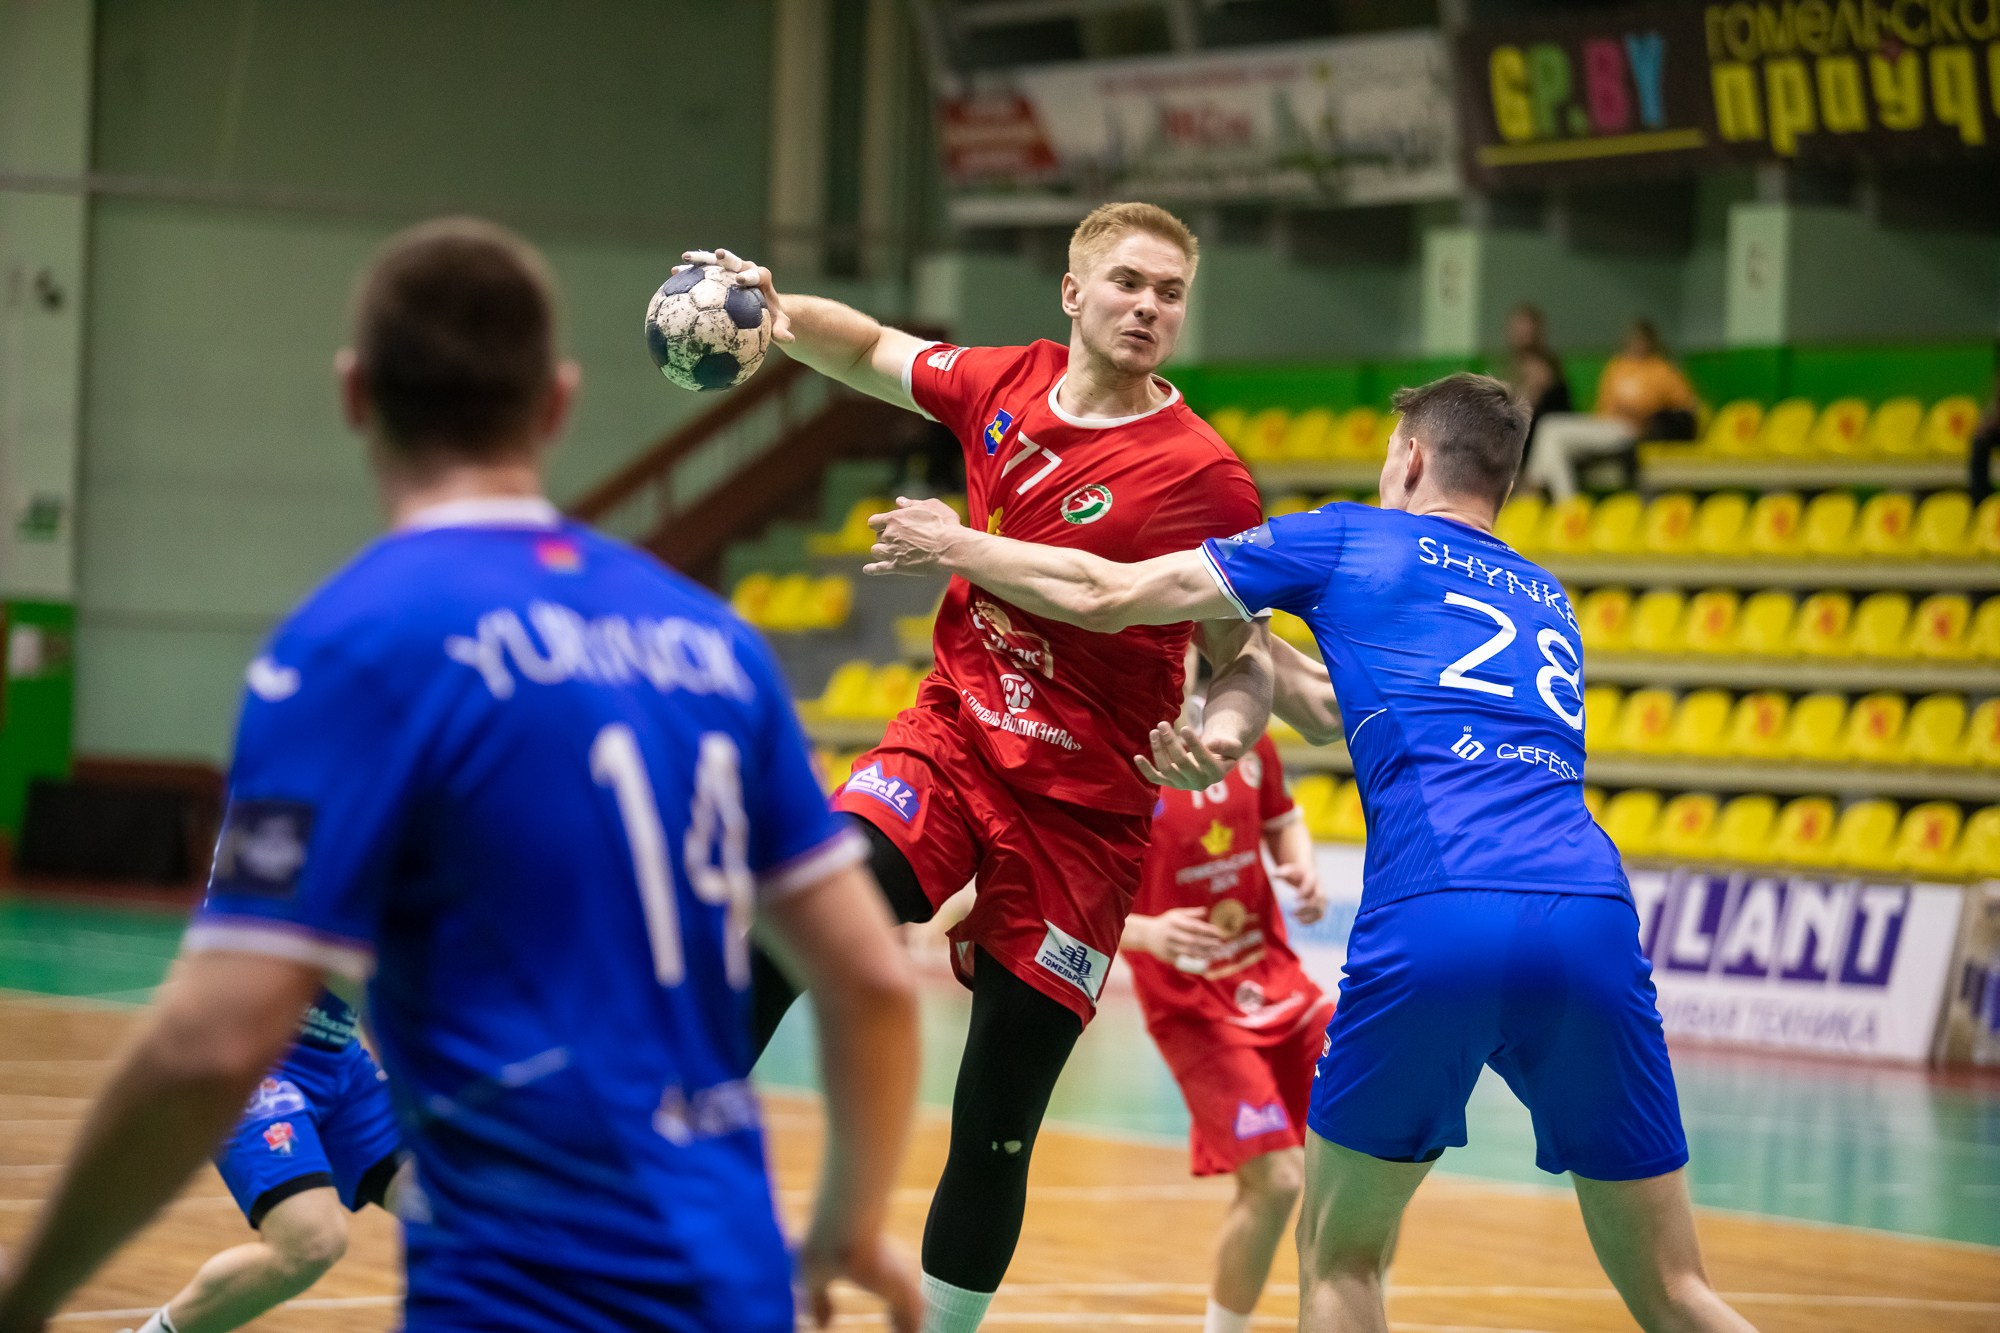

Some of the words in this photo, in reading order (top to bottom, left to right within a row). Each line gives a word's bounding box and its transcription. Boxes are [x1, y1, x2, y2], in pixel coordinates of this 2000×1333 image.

[1000, 430, 1063, 496] 77
[1417, 536, 1582, 637] SHYNKE
[1439, 591, 1584, 731] 28
[589, 722, 756, 991] 14
[1041, 955, 1086, 987] ГОМЕЛЬРЕ
[1630, 871, 1905, 976] TLANT
